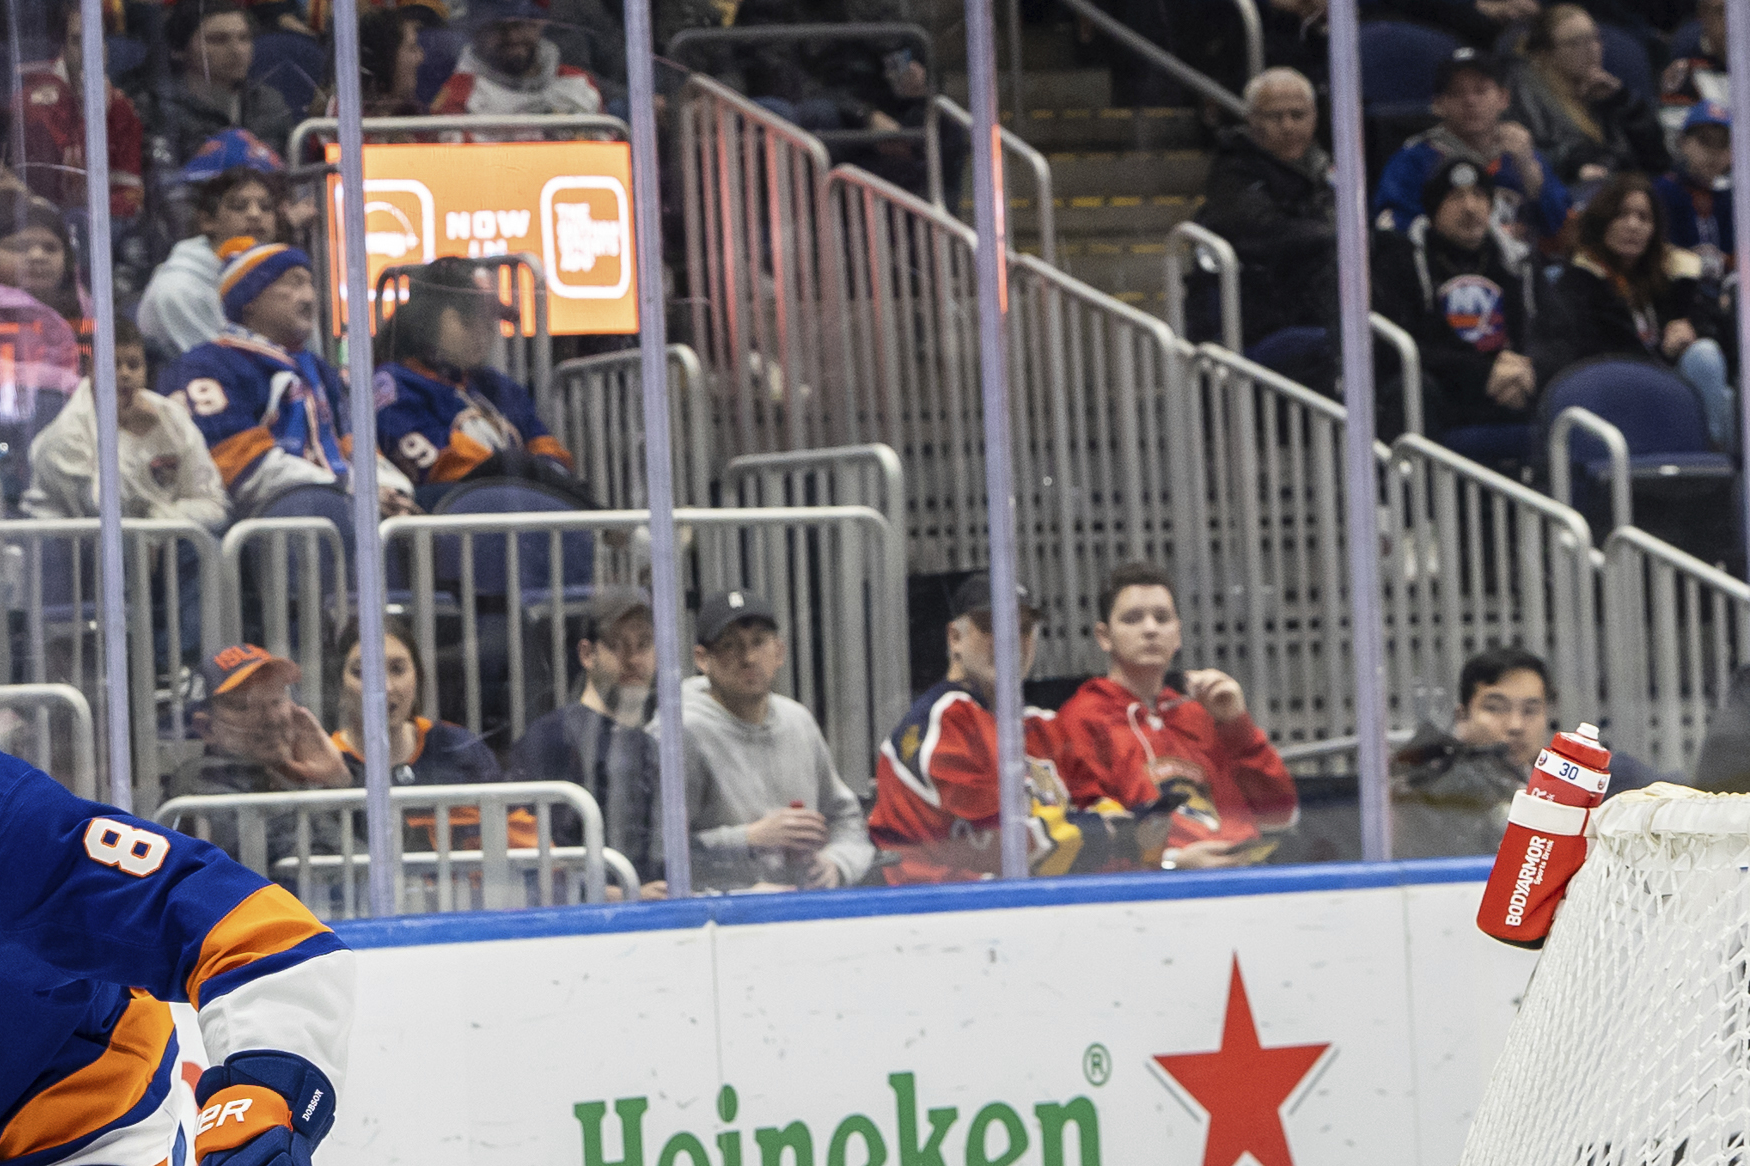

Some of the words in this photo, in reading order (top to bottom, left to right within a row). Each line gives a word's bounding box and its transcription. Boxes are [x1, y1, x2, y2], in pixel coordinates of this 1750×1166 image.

[446, 210, 530, 239] NOW
[1559, 762, 1579, 780] 30
[83, 816, 170, 878] 8
[1505, 835, 1547, 927] BODYARMOR
[1533, 860, 1547, 886] Sports
[302, 1089, 325, 1122] DOBSON
